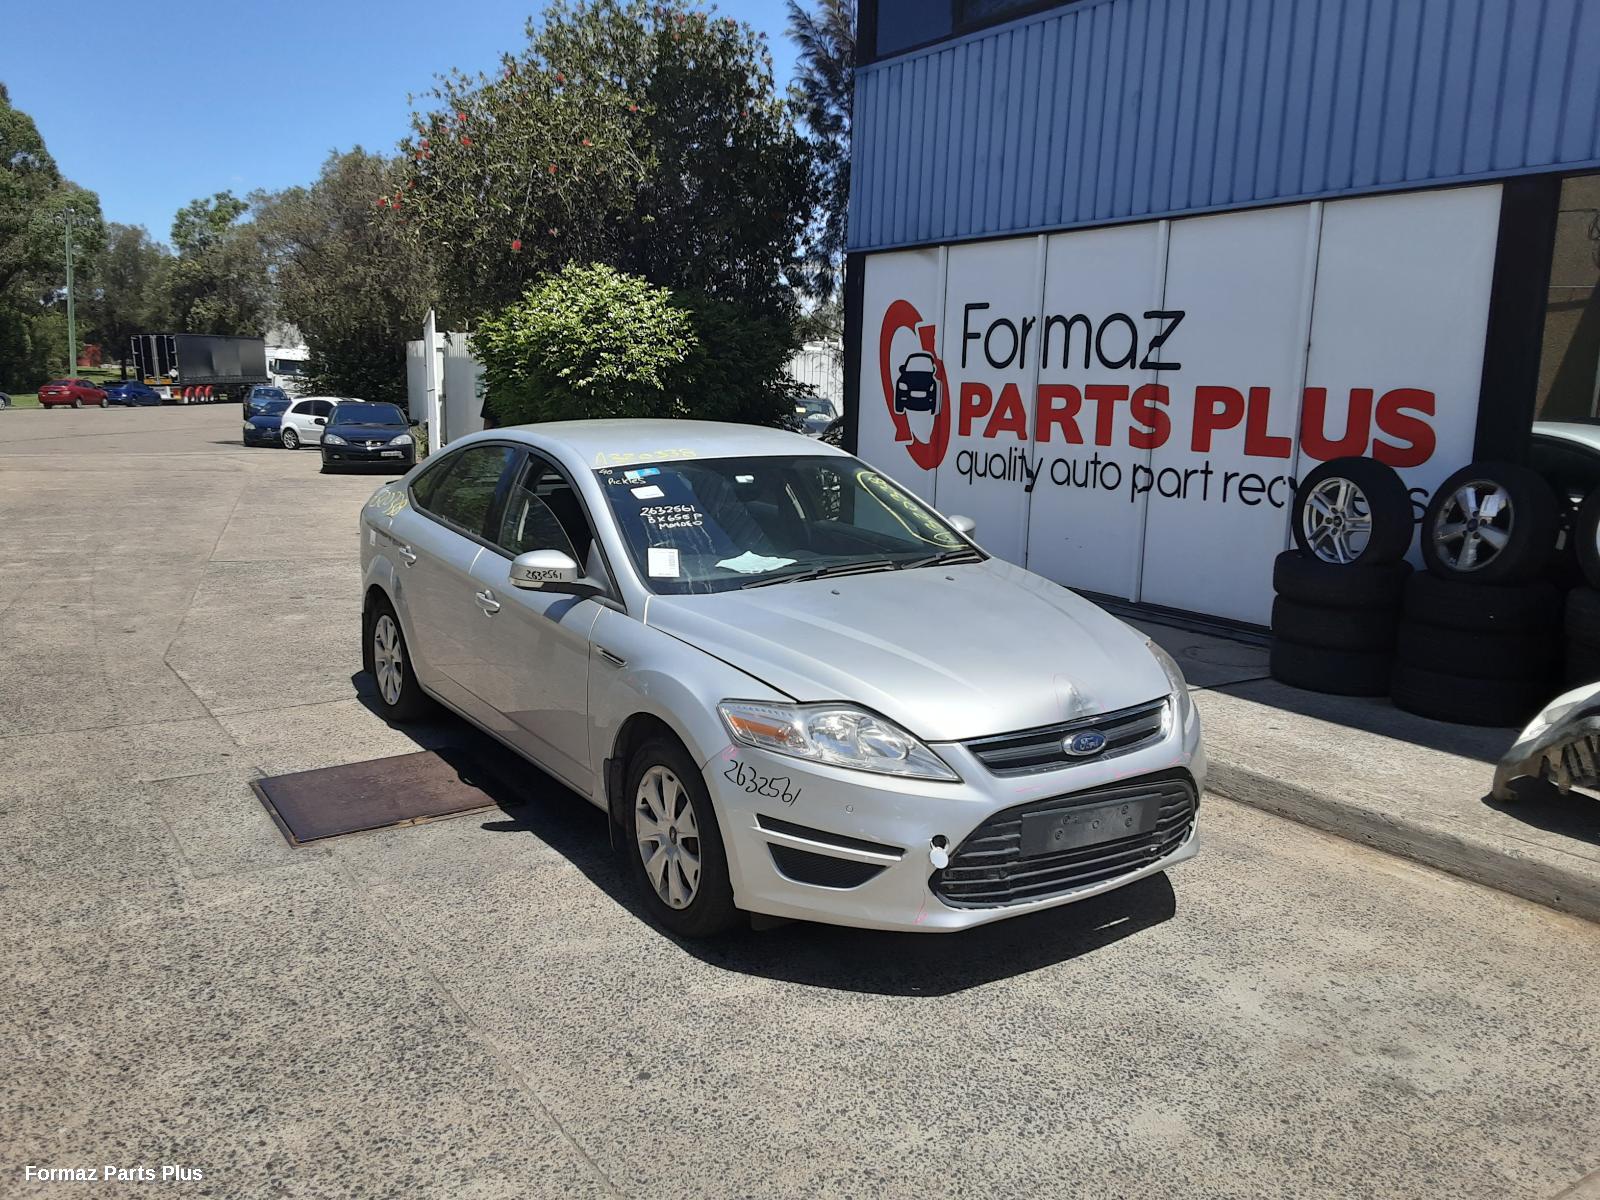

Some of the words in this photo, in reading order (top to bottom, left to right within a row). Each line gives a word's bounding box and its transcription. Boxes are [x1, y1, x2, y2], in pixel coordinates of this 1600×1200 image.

[962, 302, 1185, 370] Formaz
[958, 382, 1172, 449] PARTS
[1191, 385, 1437, 468] PLUS
[956, 447, 1043, 493] quality
[1050, 452, 1122, 490] auto
[1131, 460, 1214, 503] part
[639, 504, 696, 517] 2632561
[525, 569, 562, 580] 2632561
[723, 759, 802, 808] 2632561
